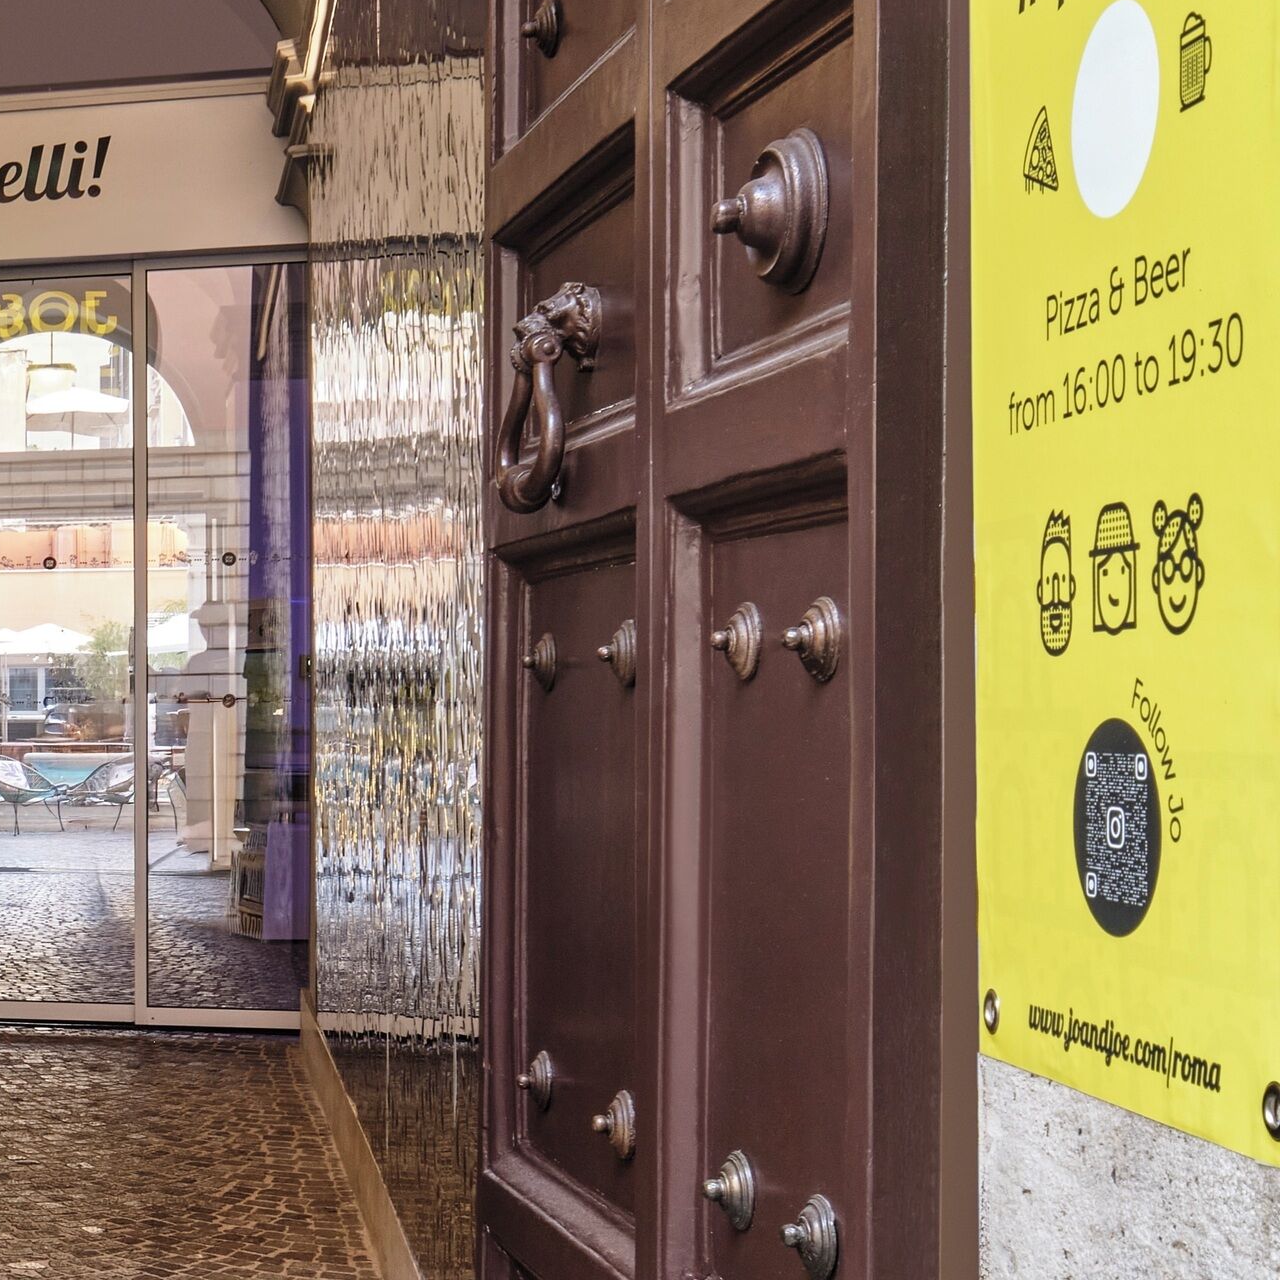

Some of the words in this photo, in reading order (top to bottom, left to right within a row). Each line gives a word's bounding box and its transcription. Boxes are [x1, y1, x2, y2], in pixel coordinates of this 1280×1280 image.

[1047, 288, 1099, 340] Pizza
[1109, 266, 1124, 315] &
[1135, 248, 1190, 306] Beer
[1009, 390, 1054, 434] from
[1063, 354, 1125, 418] 16:00
[1135, 352, 1159, 395] to
[1169, 313, 1243, 386] 19:30
[1131, 677, 1177, 782] Follow
[1168, 794, 1184, 843] Jo
[1029, 1005, 1221, 1092] www.joandjoe.com/roma
